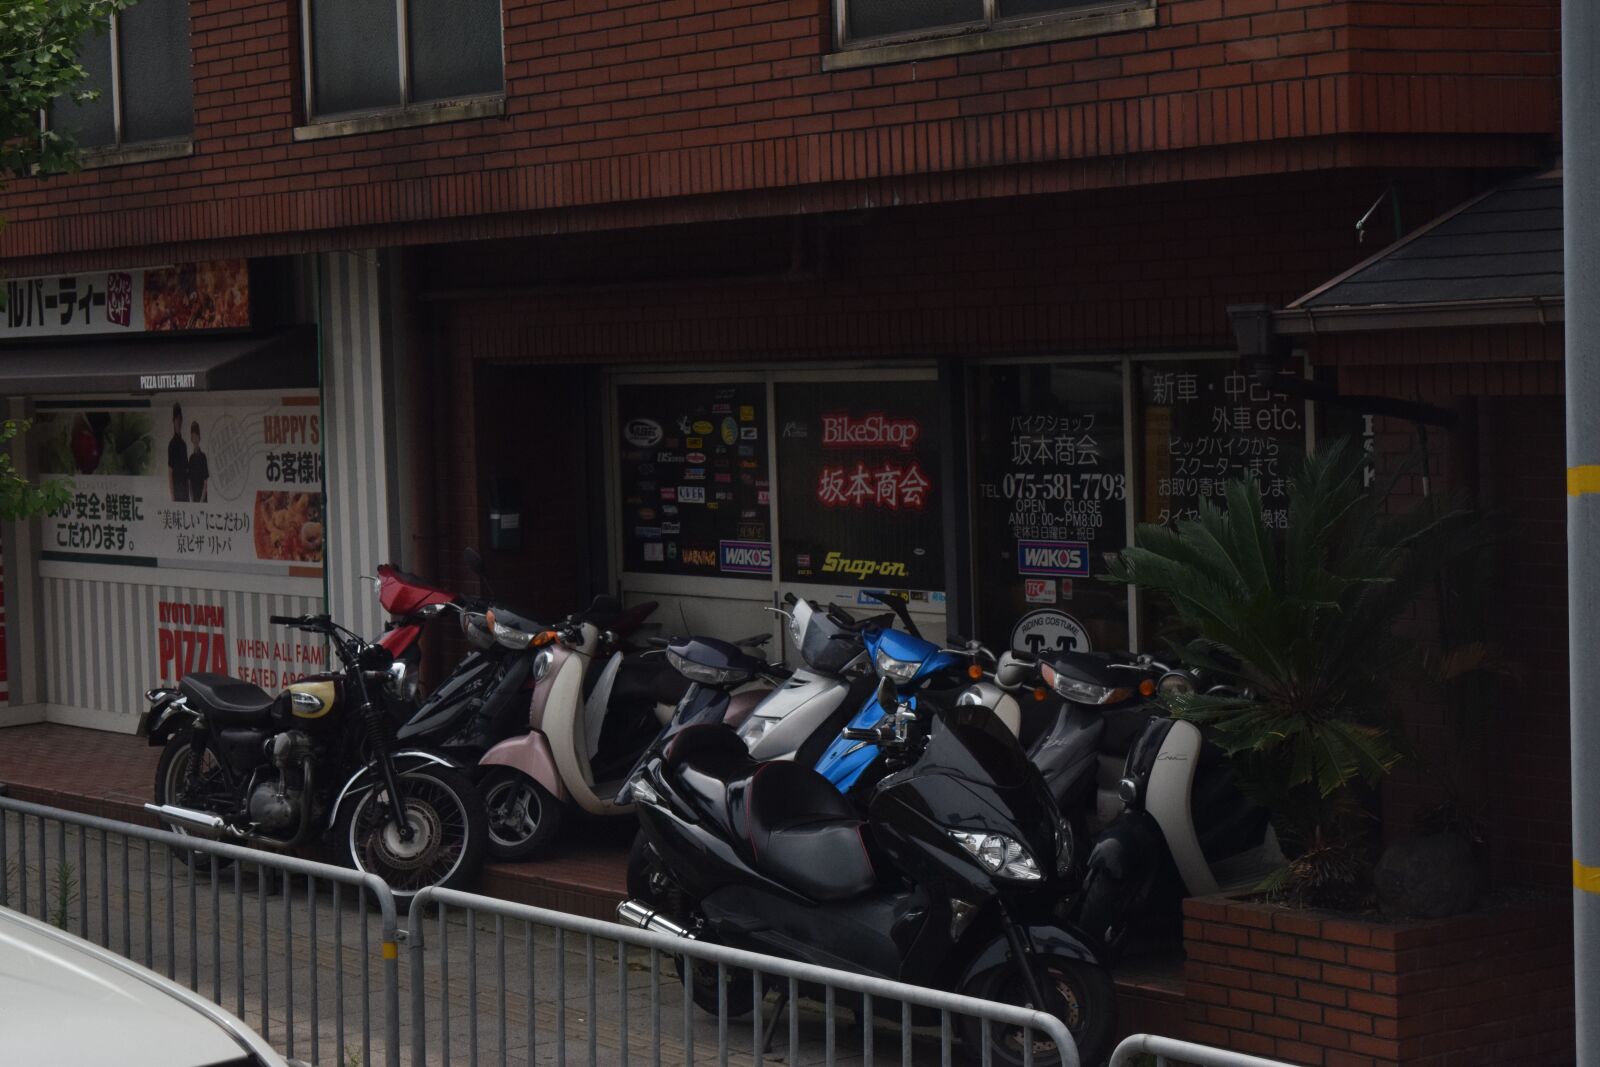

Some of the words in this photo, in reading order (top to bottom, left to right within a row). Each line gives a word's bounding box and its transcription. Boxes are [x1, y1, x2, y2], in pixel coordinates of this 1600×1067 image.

[0, 277, 106, 328] ルパーティー
[140, 375, 157, 390] PIZZA
[157, 374, 176, 389] LITTLE
[176, 373, 196, 388] PARTY
[263, 415, 307, 445] HAPPY
[822, 417, 917, 448] BikeShop
[1011, 433, 1100, 466] 坂本商会
[818, 464, 929, 506] 坂本商会
[980, 483, 1000, 498] TEL
[1003, 473, 1126, 500] 075-581-7793
[1016, 499, 1046, 512] OPEN
[1064, 500, 1101, 514] CLOSE
[56, 522, 135, 552] こだわります。
[821, 551, 909, 581] Snap-on
[159, 602, 191, 625] KYOTO
[194, 605, 225, 628] JAPAN
[1022, 618, 1044, 634] RIDING
[1045, 617, 1080, 636] COSTUME
[159, 628, 228, 682] PIZZA
[237, 639, 269, 659] WHEN
[273, 642, 293, 662] ALL
[238, 666, 278, 689] SEATED
